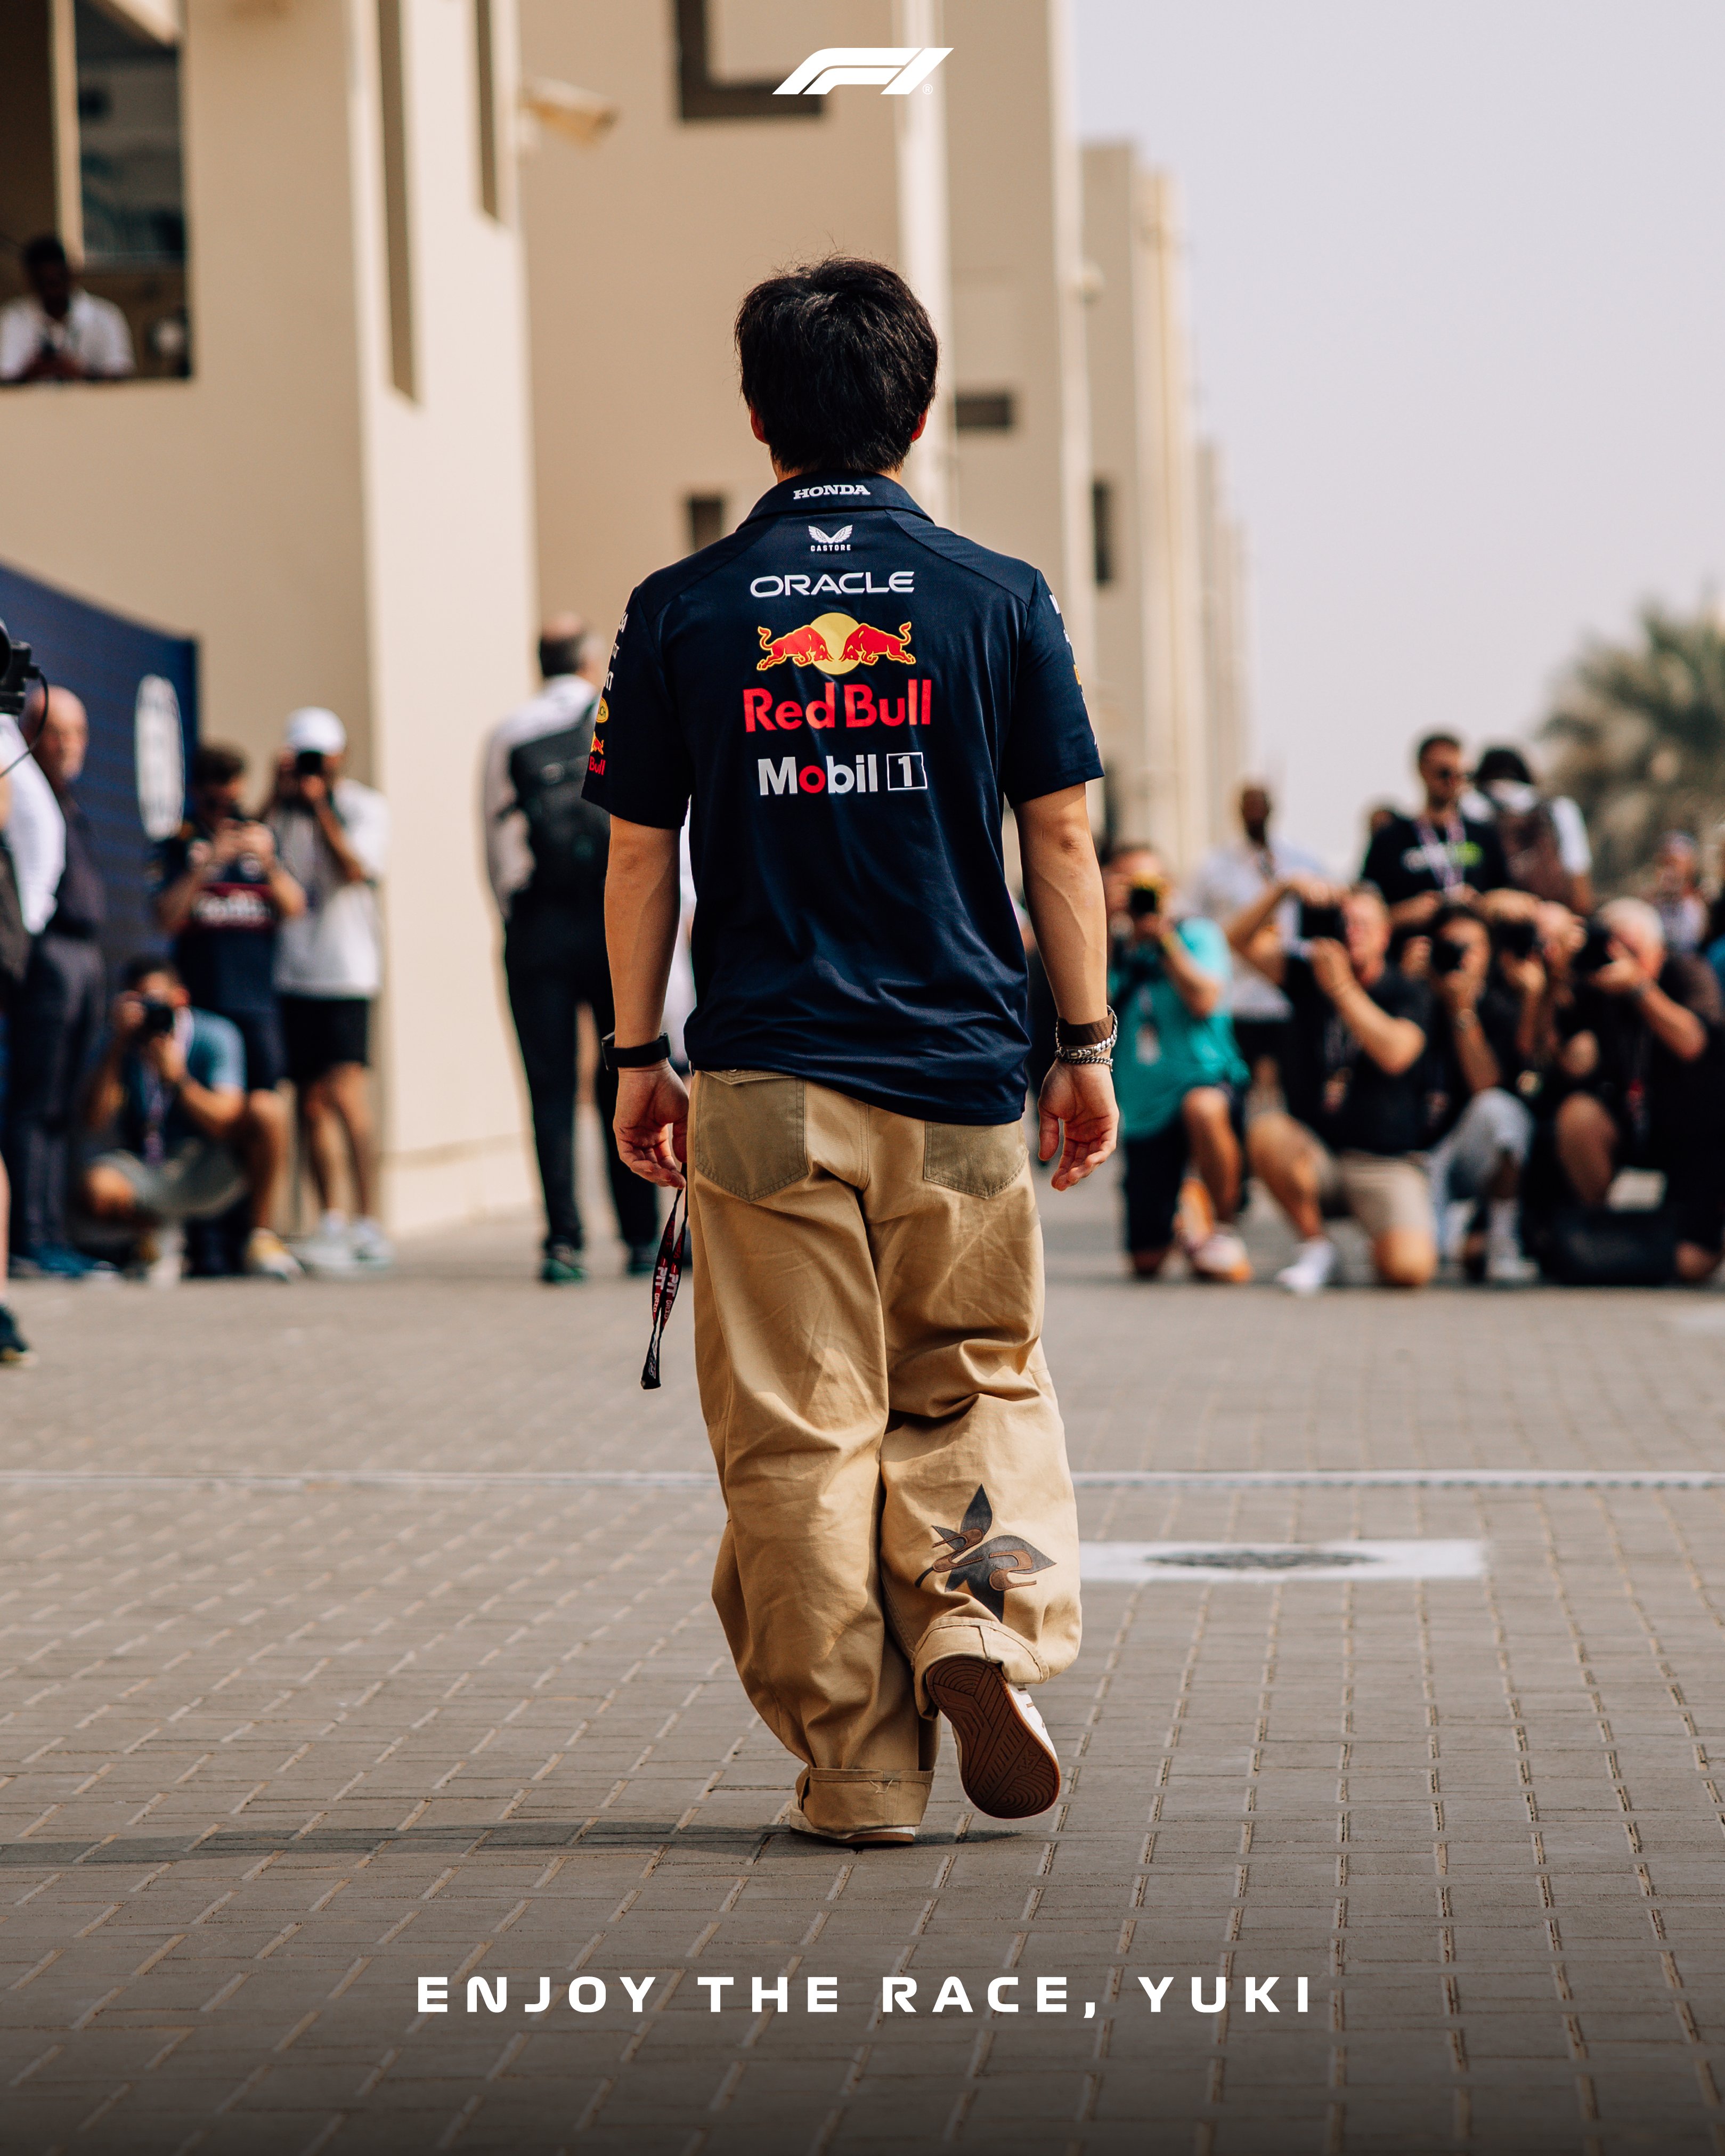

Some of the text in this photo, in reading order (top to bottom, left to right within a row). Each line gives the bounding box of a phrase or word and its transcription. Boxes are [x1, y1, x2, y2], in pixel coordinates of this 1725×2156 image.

[793, 484, 871, 500] HONDA
[810, 542, 851, 552] CASTORE
[750, 571, 915, 598] ORACLE
[743, 679, 932, 733] Red Bull
[589, 755, 606, 776] Bull
[758, 754, 878, 796] Mobil
[655, 1266, 668, 1290] PIT
[666, 1273, 679, 1297] PIT
